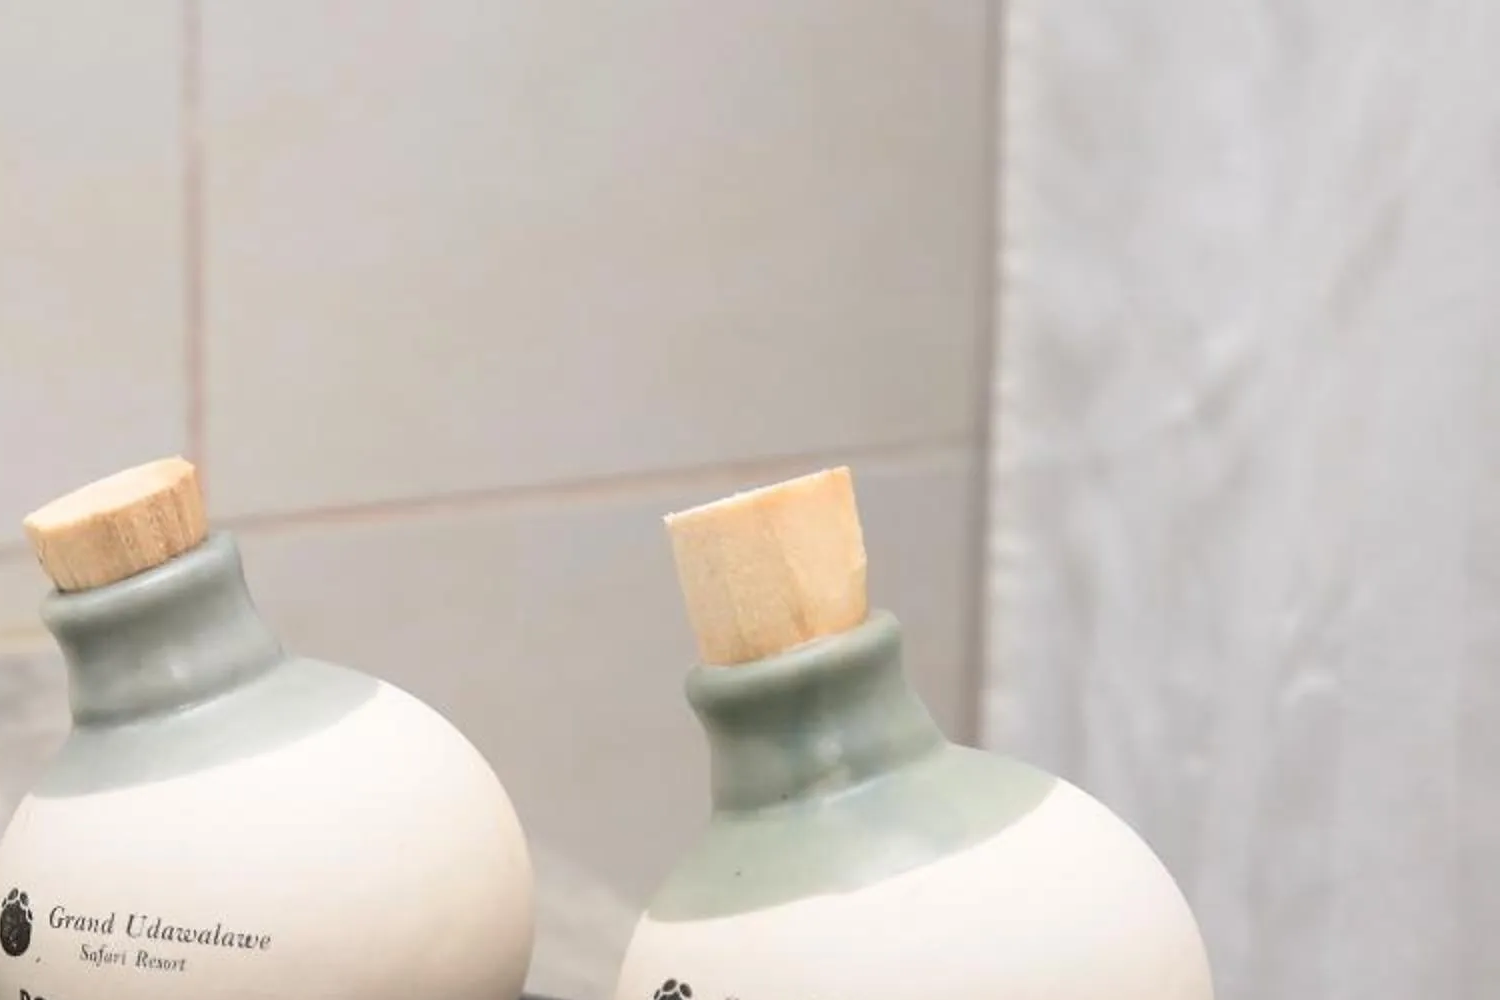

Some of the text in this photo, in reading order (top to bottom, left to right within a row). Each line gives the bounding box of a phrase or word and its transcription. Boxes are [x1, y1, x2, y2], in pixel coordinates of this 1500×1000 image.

[49, 905, 272, 951] Grand Udawalawe
[78, 943, 188, 973] Safari Resort
